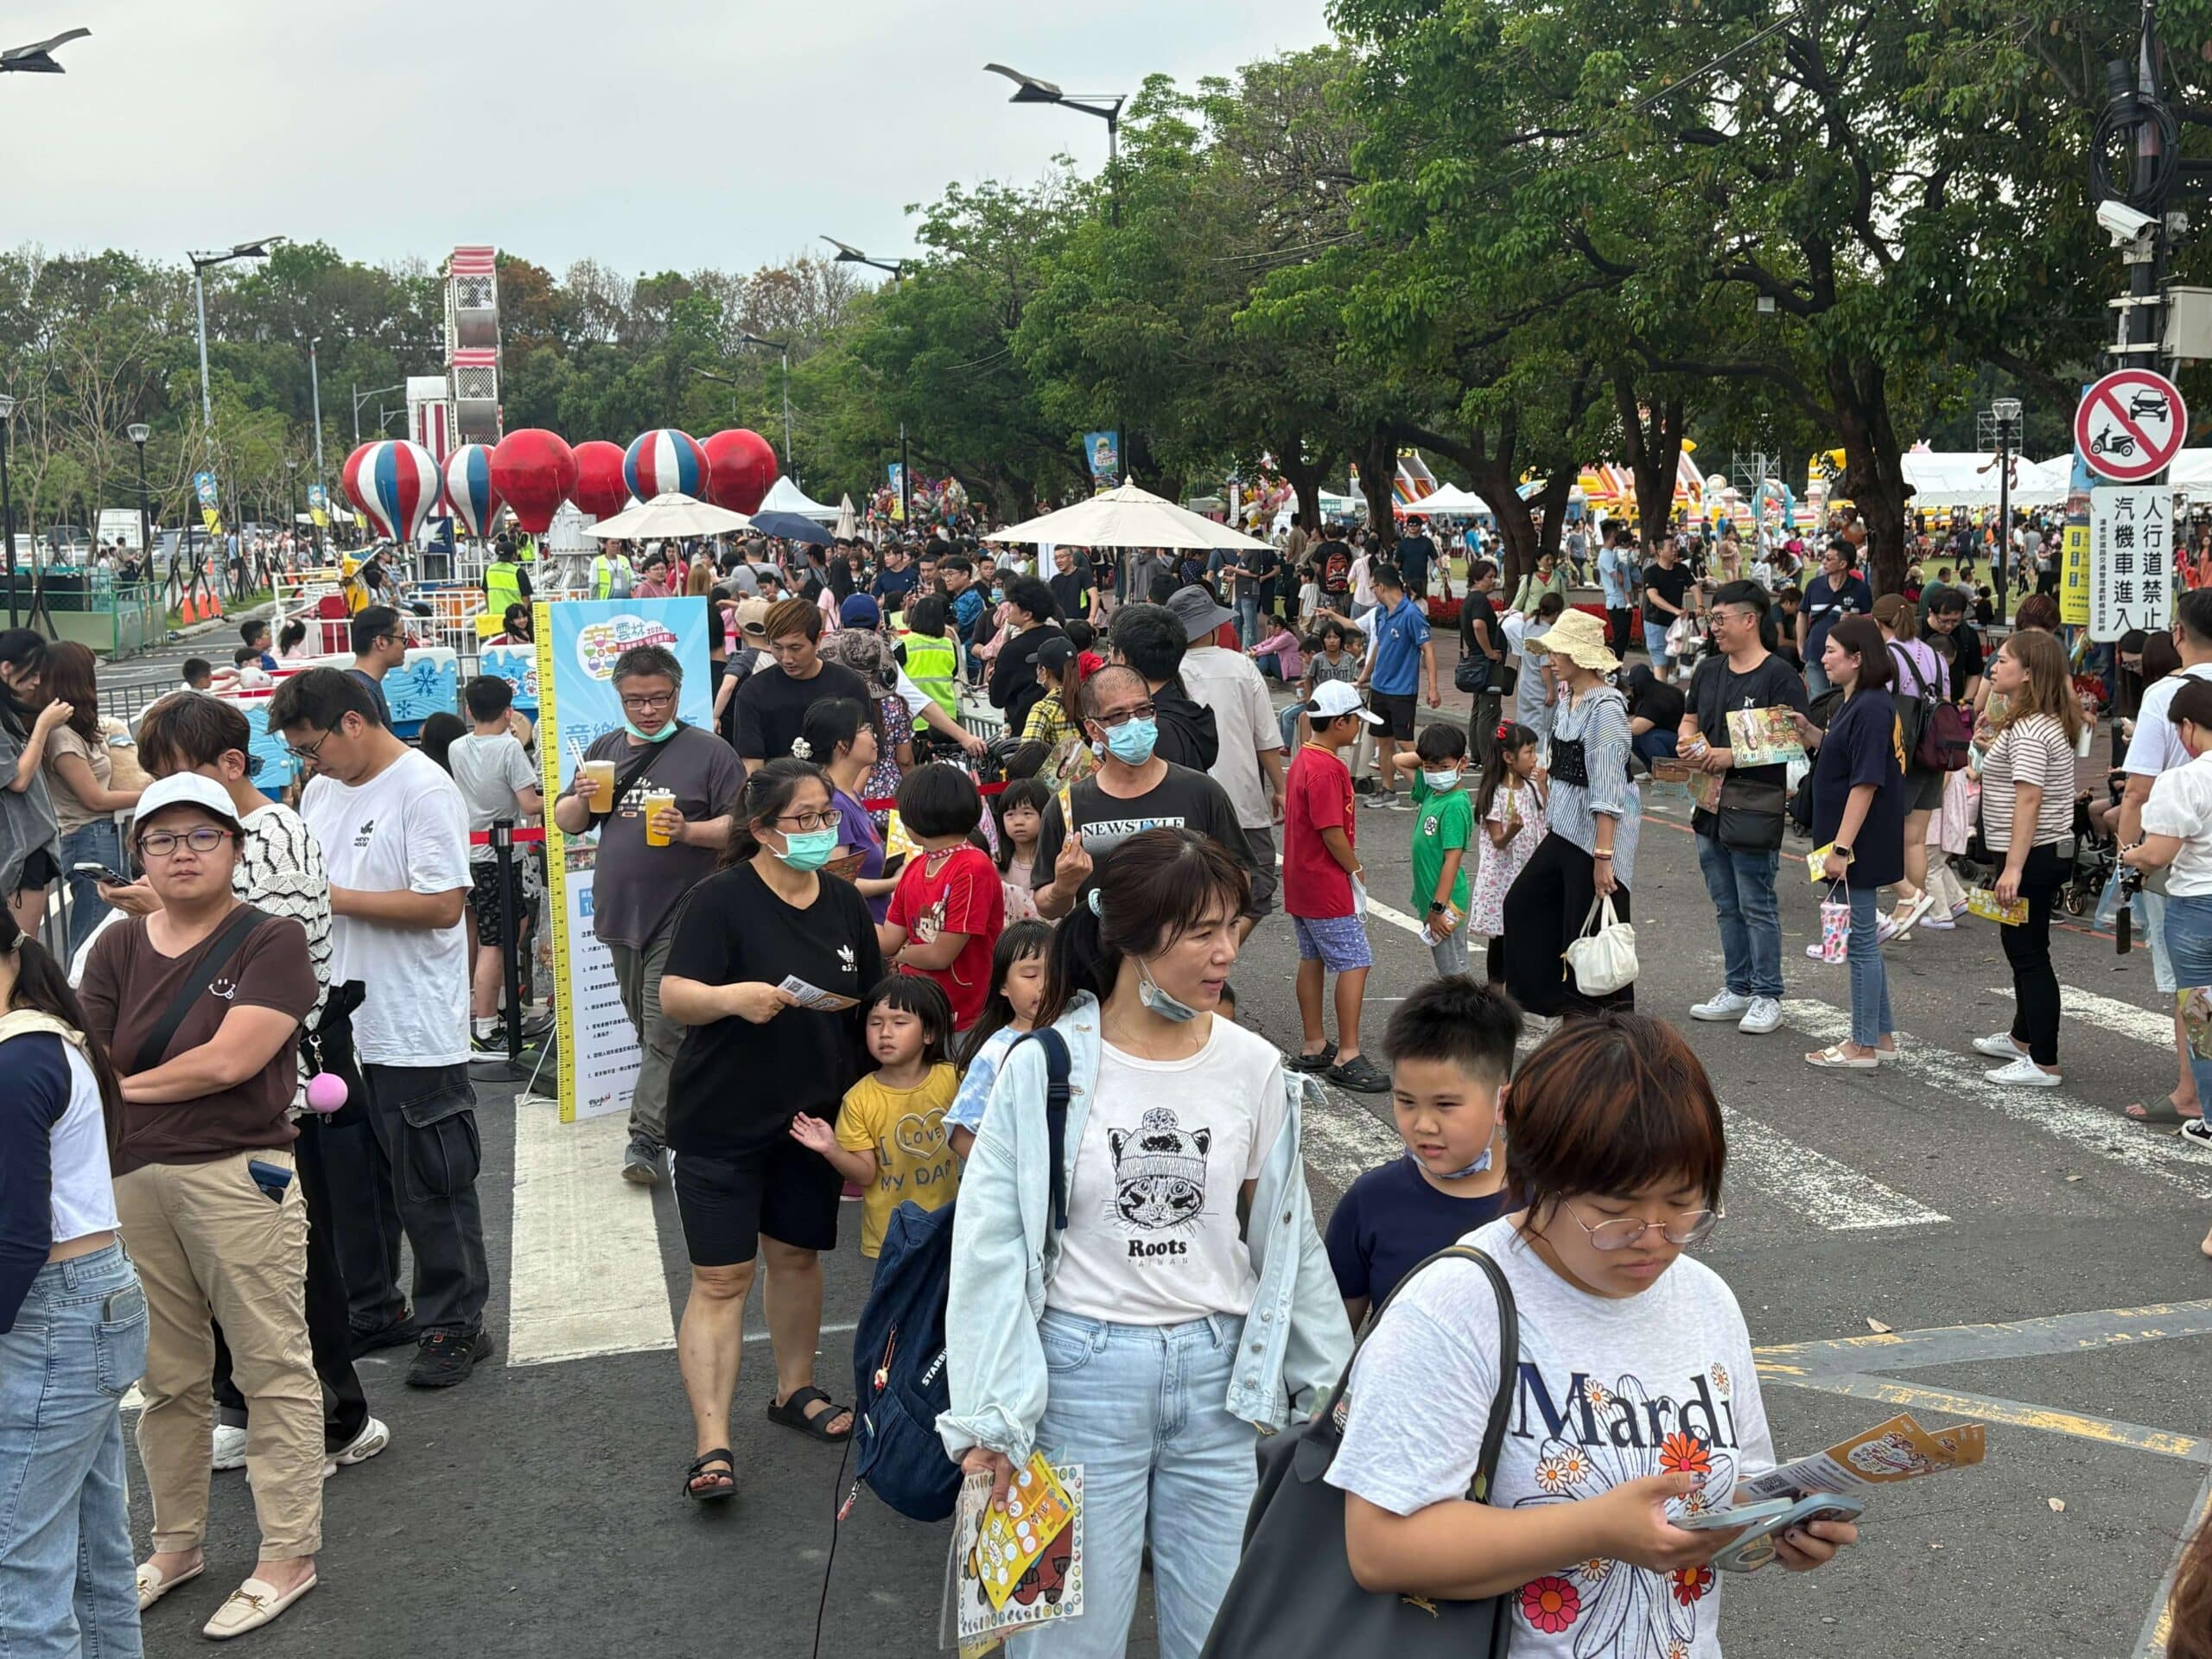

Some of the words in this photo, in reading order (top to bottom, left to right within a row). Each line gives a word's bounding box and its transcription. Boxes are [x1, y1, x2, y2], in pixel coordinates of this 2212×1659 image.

[2113, 496, 2135, 632] 汽機車進入
[2143, 495, 2164, 631] 人行道禁止
[616, 621, 645, 640] 雲林
[904, 1127, 941, 1146] LOVE
[880, 1136, 892, 1166] I
[881, 1173, 905, 1191] MY
[1128, 1239, 1187, 1257] Roots
[1512, 1363, 1739, 1449] Mardi
